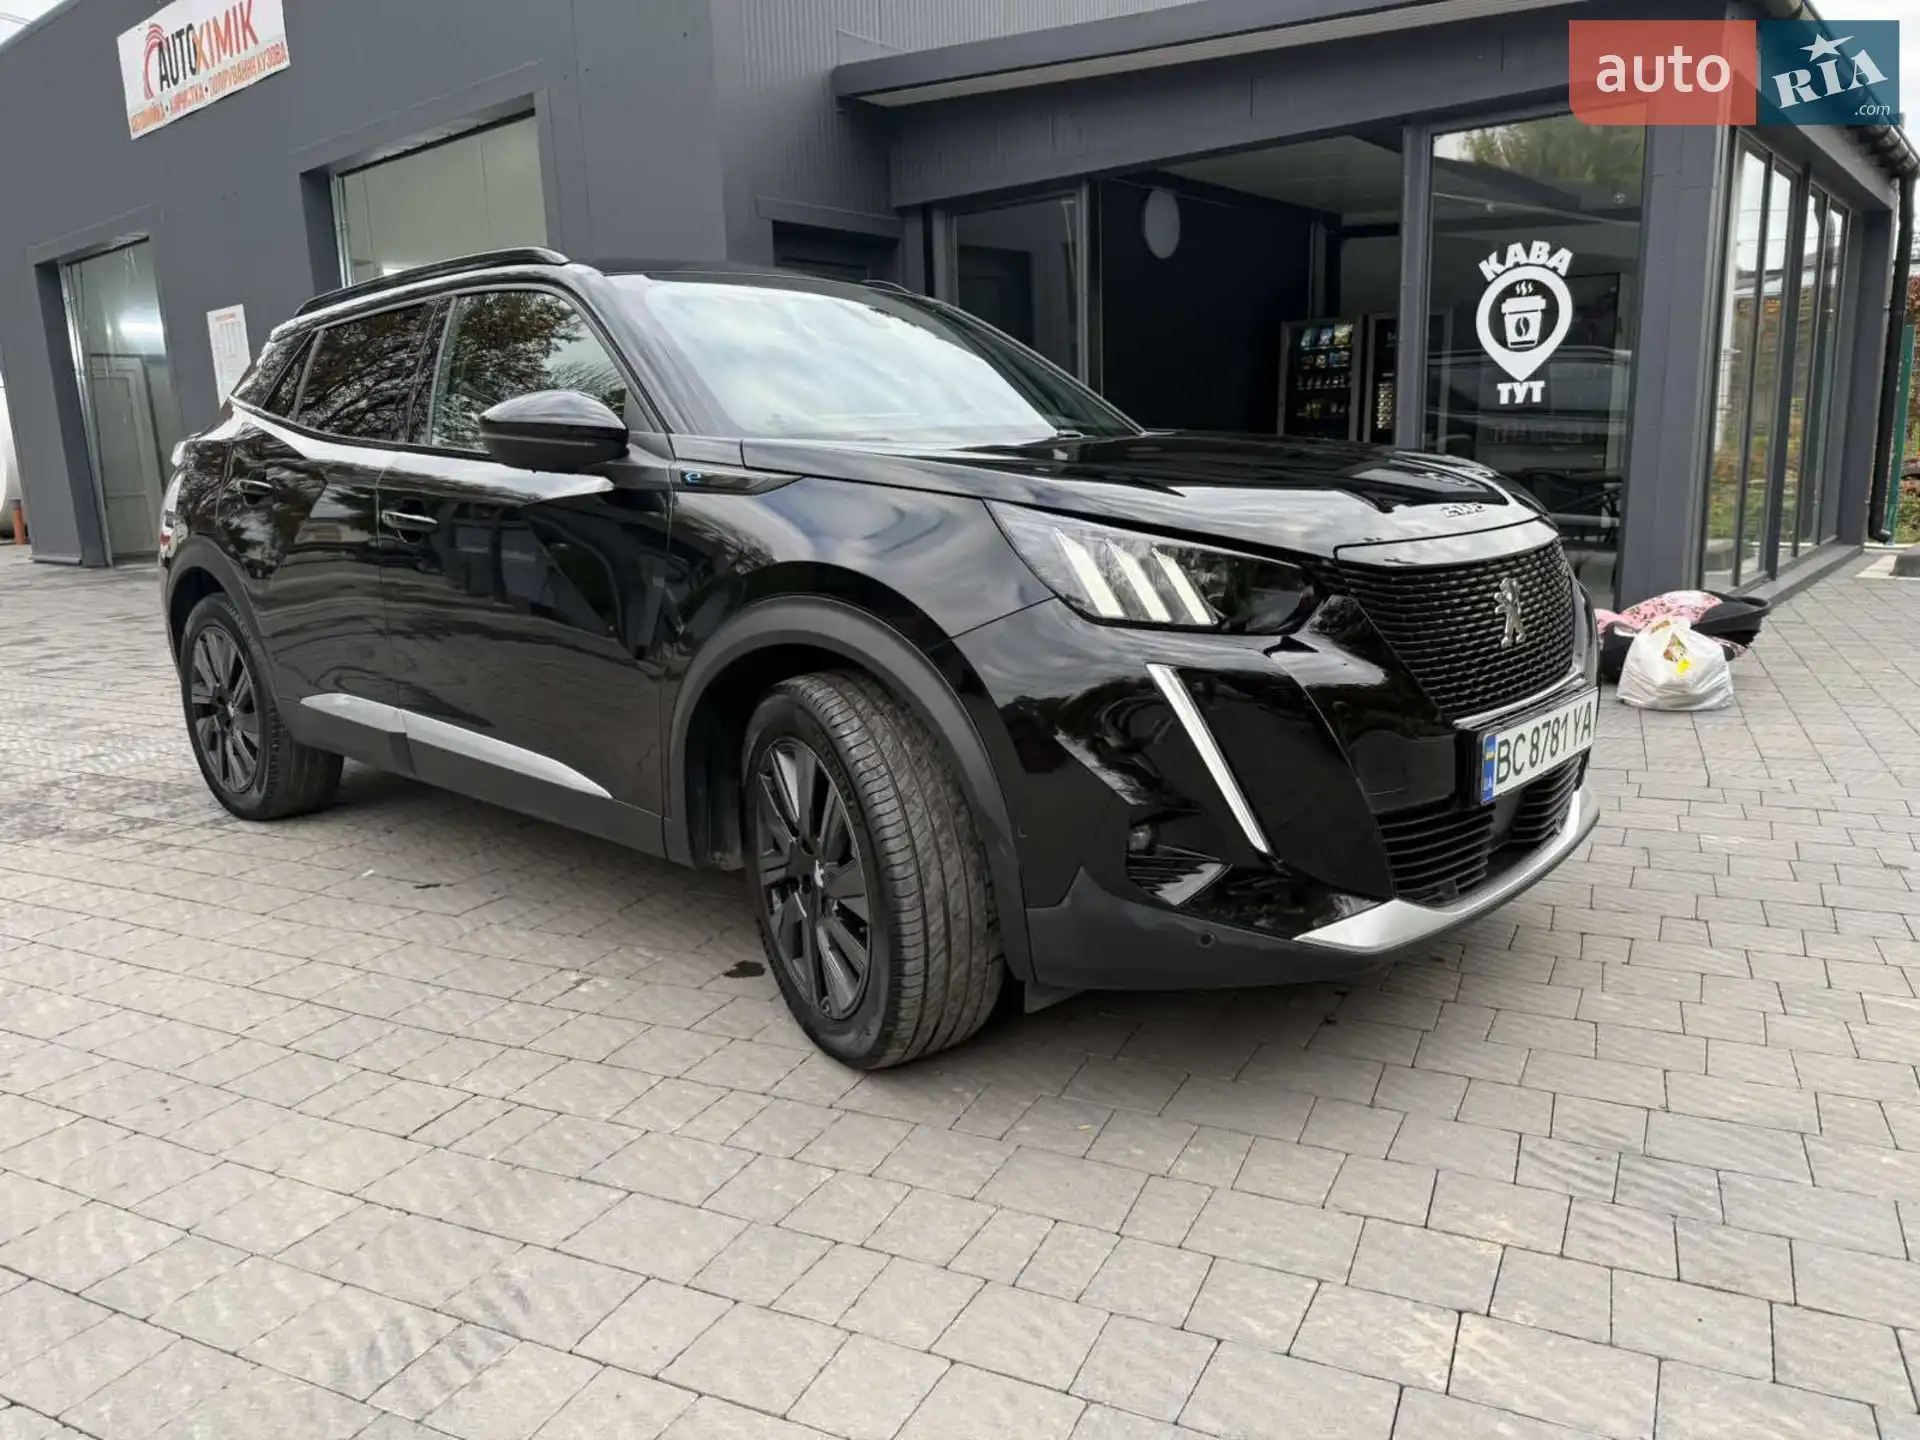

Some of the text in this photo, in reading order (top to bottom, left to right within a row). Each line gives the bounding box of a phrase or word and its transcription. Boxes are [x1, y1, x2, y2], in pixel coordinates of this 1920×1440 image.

[1478, 240, 1573, 282] КАВА
[1497, 380, 1545, 404] ТУТ
[1496, 700, 1592, 785] BC 8781 YA
